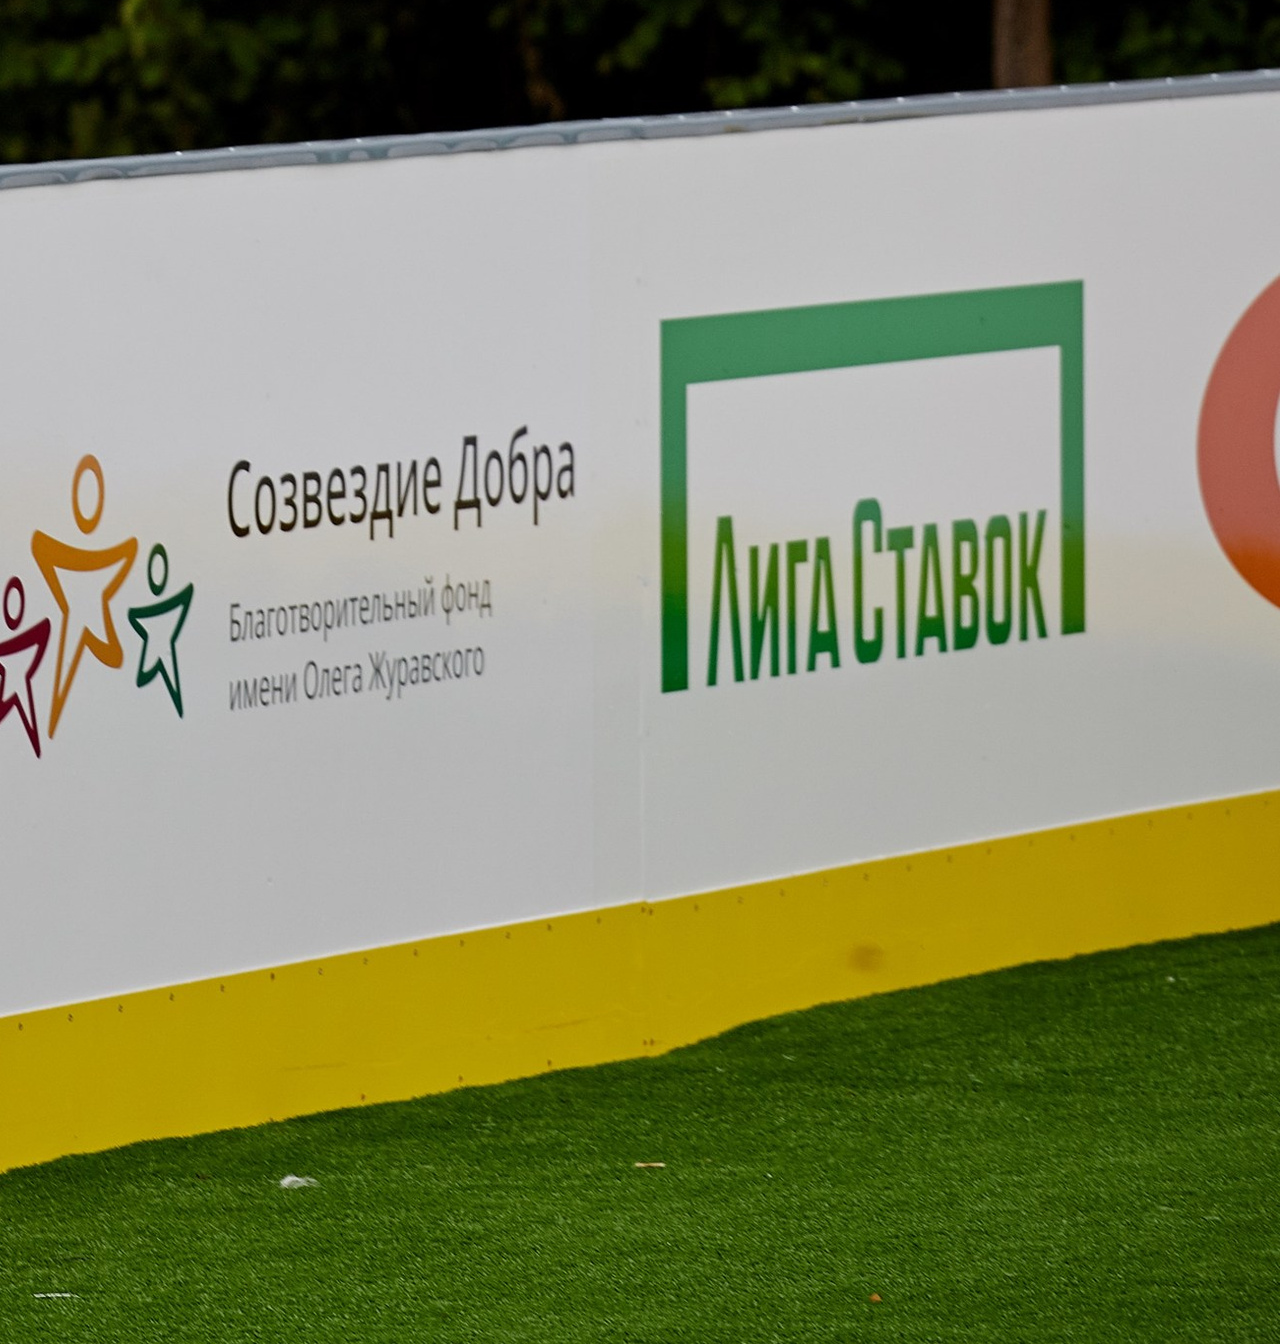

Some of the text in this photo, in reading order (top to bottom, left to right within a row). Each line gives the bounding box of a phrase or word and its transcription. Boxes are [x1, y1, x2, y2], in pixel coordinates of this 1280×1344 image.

[227, 425, 576, 541] Созвездие Добра
[229, 575, 492, 643] Благотворительный фонд
[228, 644, 485, 711] имени Олега Журавского
